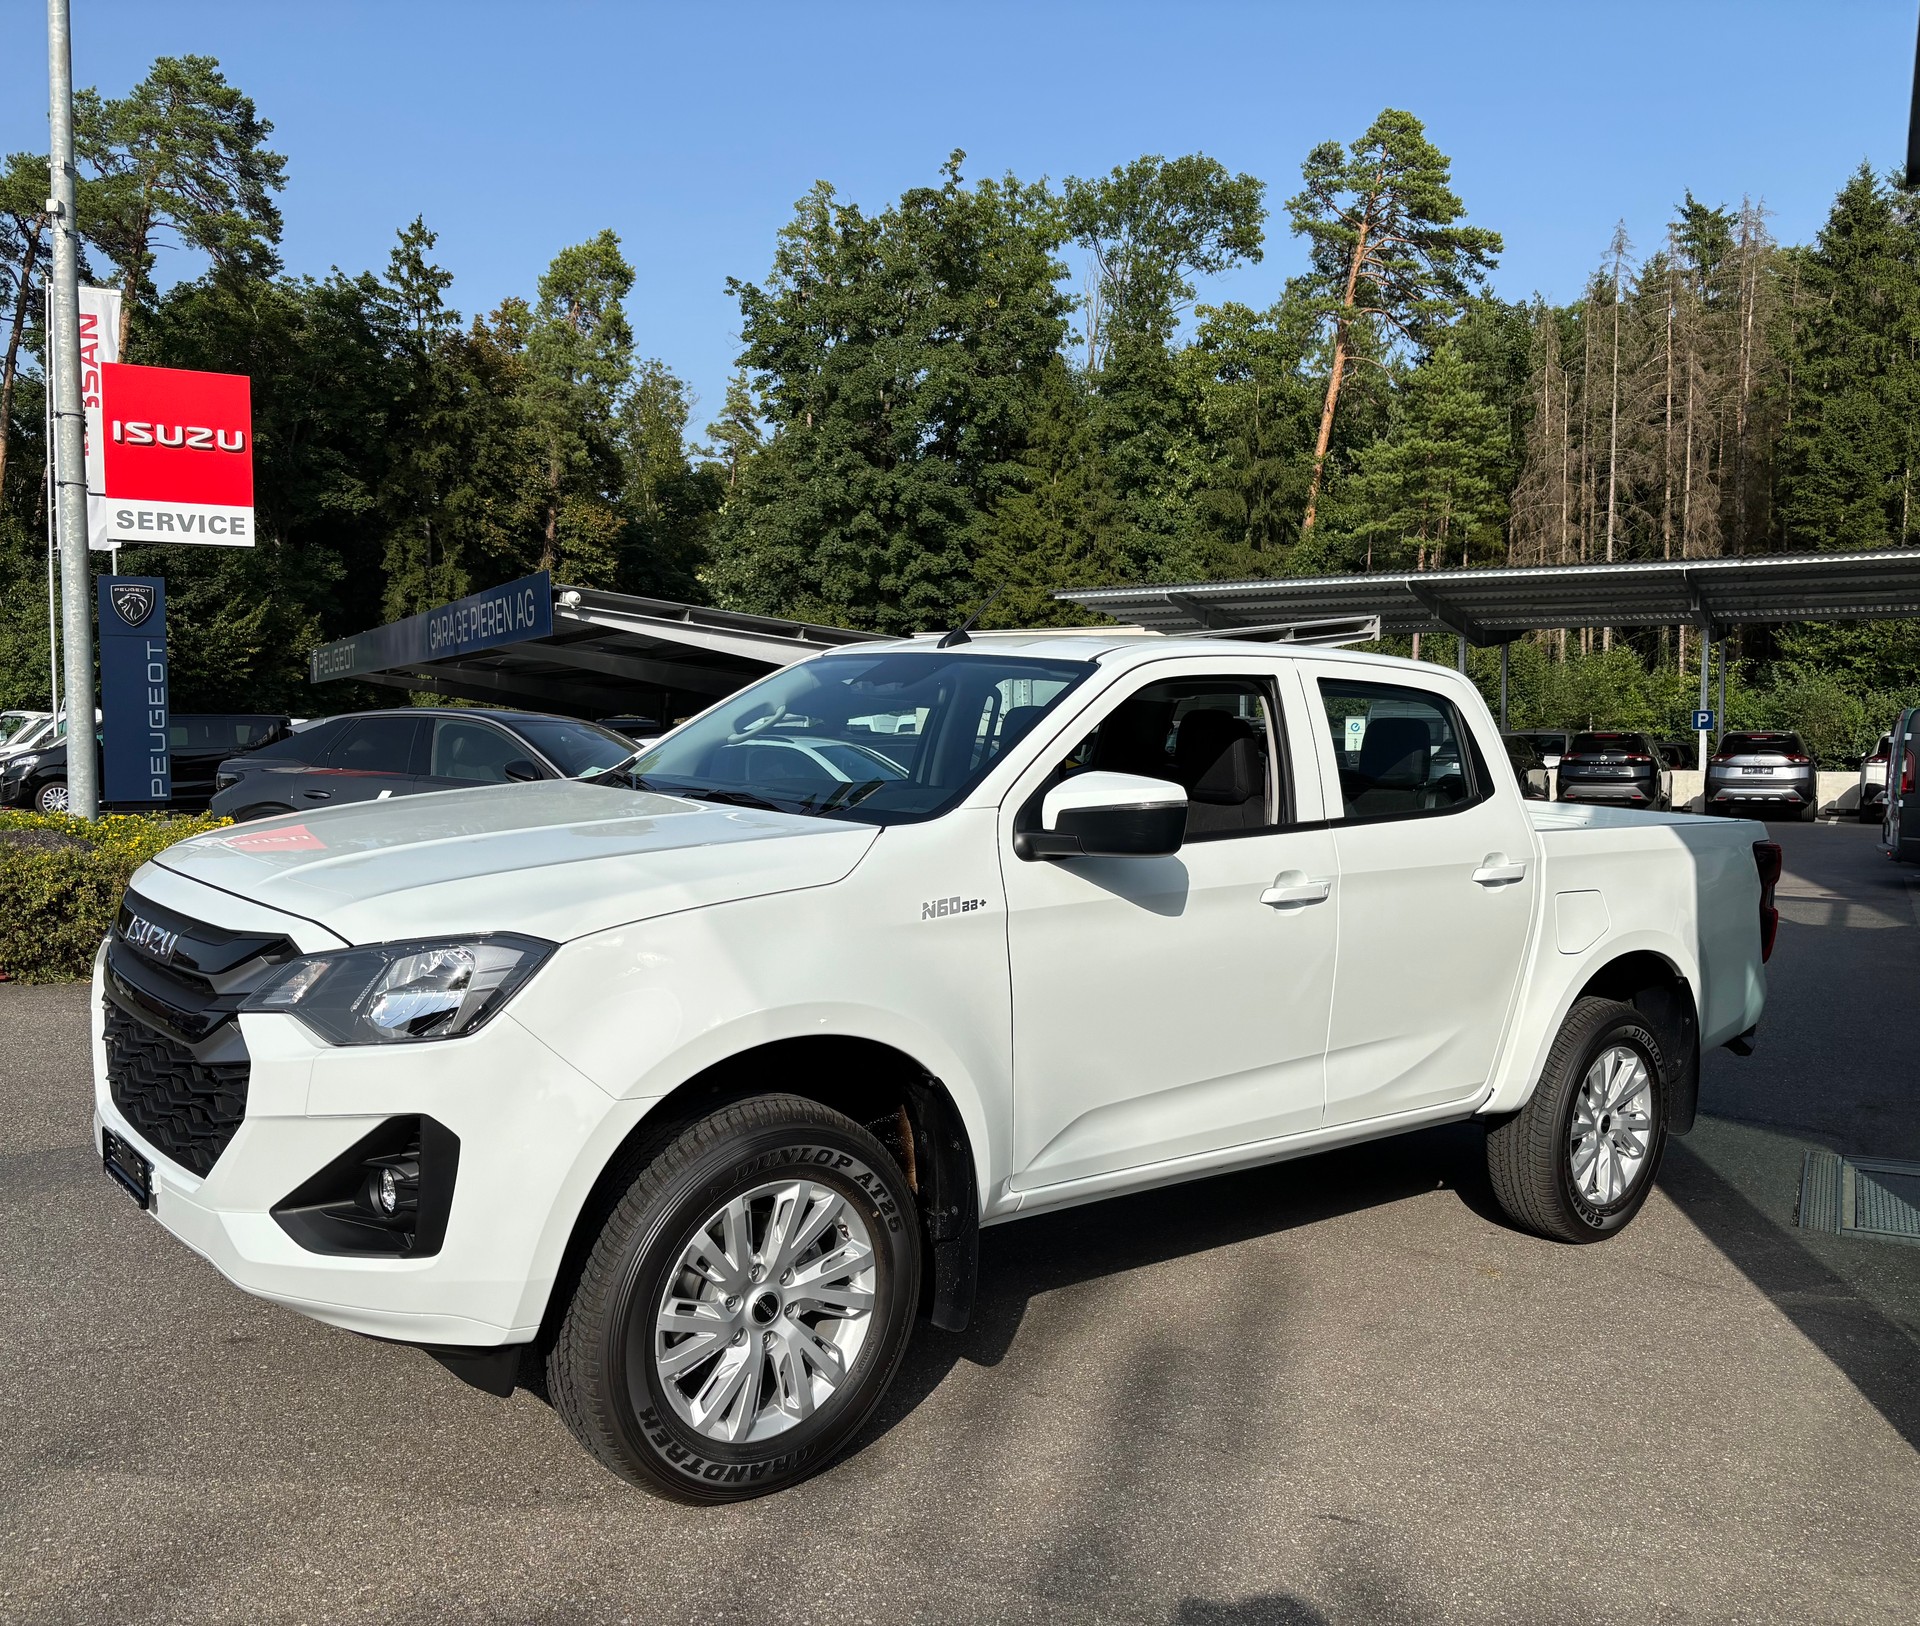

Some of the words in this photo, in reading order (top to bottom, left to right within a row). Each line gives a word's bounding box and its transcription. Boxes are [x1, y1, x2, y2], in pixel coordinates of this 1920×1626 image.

[112, 420, 246, 452] ISUZU
[116, 509, 246, 536] SERVICE
[429, 609, 469, 650] GARAGE
[470, 595, 513, 640] PIEREN
[516, 588, 535, 630] AG
[318, 643, 356, 675] PEUGEOT
[146, 640, 168, 798] PEUGEOT
[1697, 712, 1709, 728] P
[125, 914, 179, 959] ISUZU
[1632, 1028, 1665, 1074] DUNLOP
[733, 1147, 854, 1184] DUNLOP
[853, 1171, 904, 1233] AT25
[638, 1406, 816, 1483] GRANDTREK
